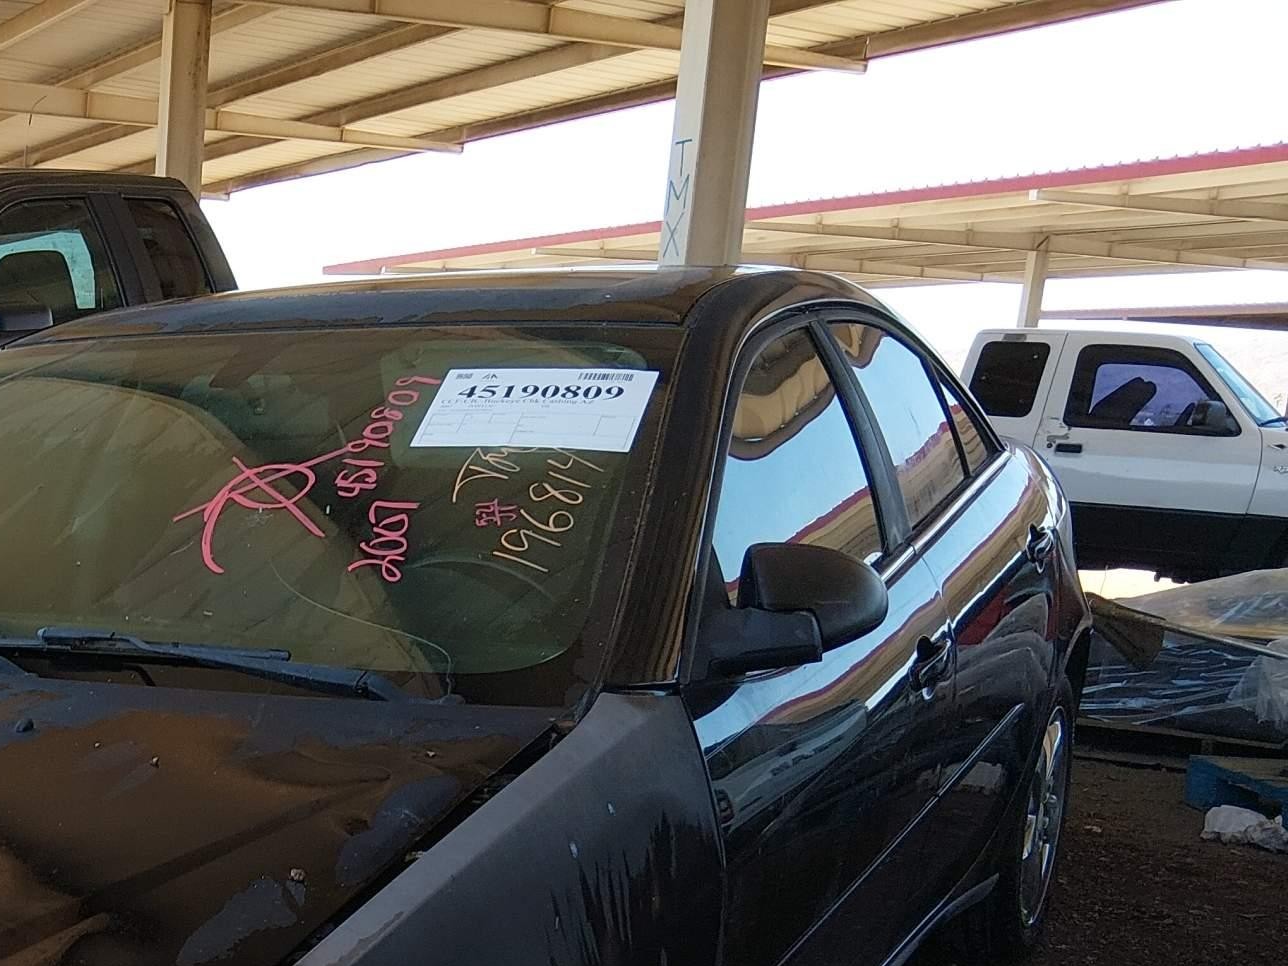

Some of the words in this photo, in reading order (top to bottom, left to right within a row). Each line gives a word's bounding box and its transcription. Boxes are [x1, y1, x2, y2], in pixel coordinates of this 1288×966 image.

[334, 375, 441, 498] 45190809
[457, 384, 624, 401] 45190809
[347, 500, 421, 583] 2007
[492, 447, 604, 573] 196814
